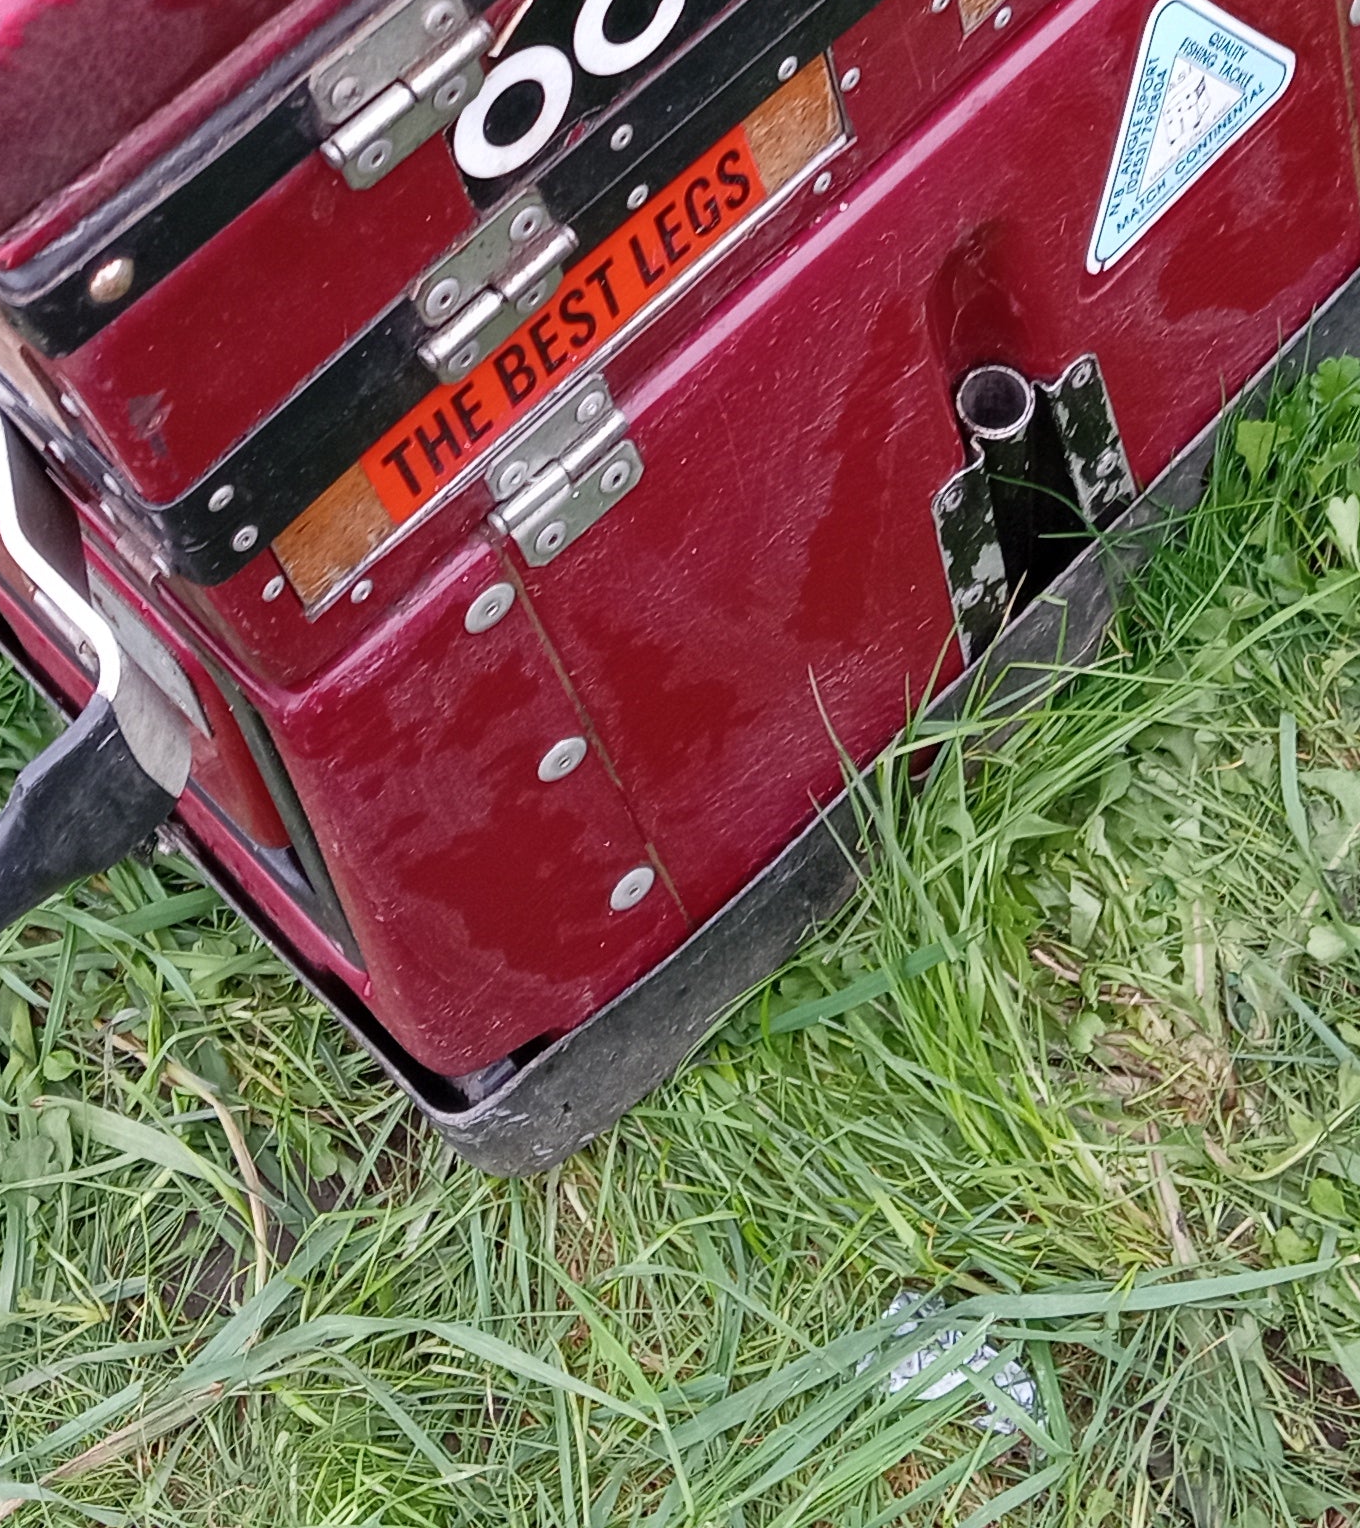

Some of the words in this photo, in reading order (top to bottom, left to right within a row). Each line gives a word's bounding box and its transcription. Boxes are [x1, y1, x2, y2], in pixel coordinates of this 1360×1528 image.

[1178, 37, 1218, 70] FISHING
[1219, 60, 1255, 90] TACKLE
[1209, 31, 1248, 64] QUALITY
[1117, 178, 1166, 234] MATCH
[1175, 82, 1265, 175] CONTINENTAL
[1121, 117, 1144, 175] ANGLE
[1137, 56, 1160, 112] SPORT
[381, 386, 496, 497] THE
[497, 256, 622, 407] BEST
[626, 149, 752, 288] LEGS
